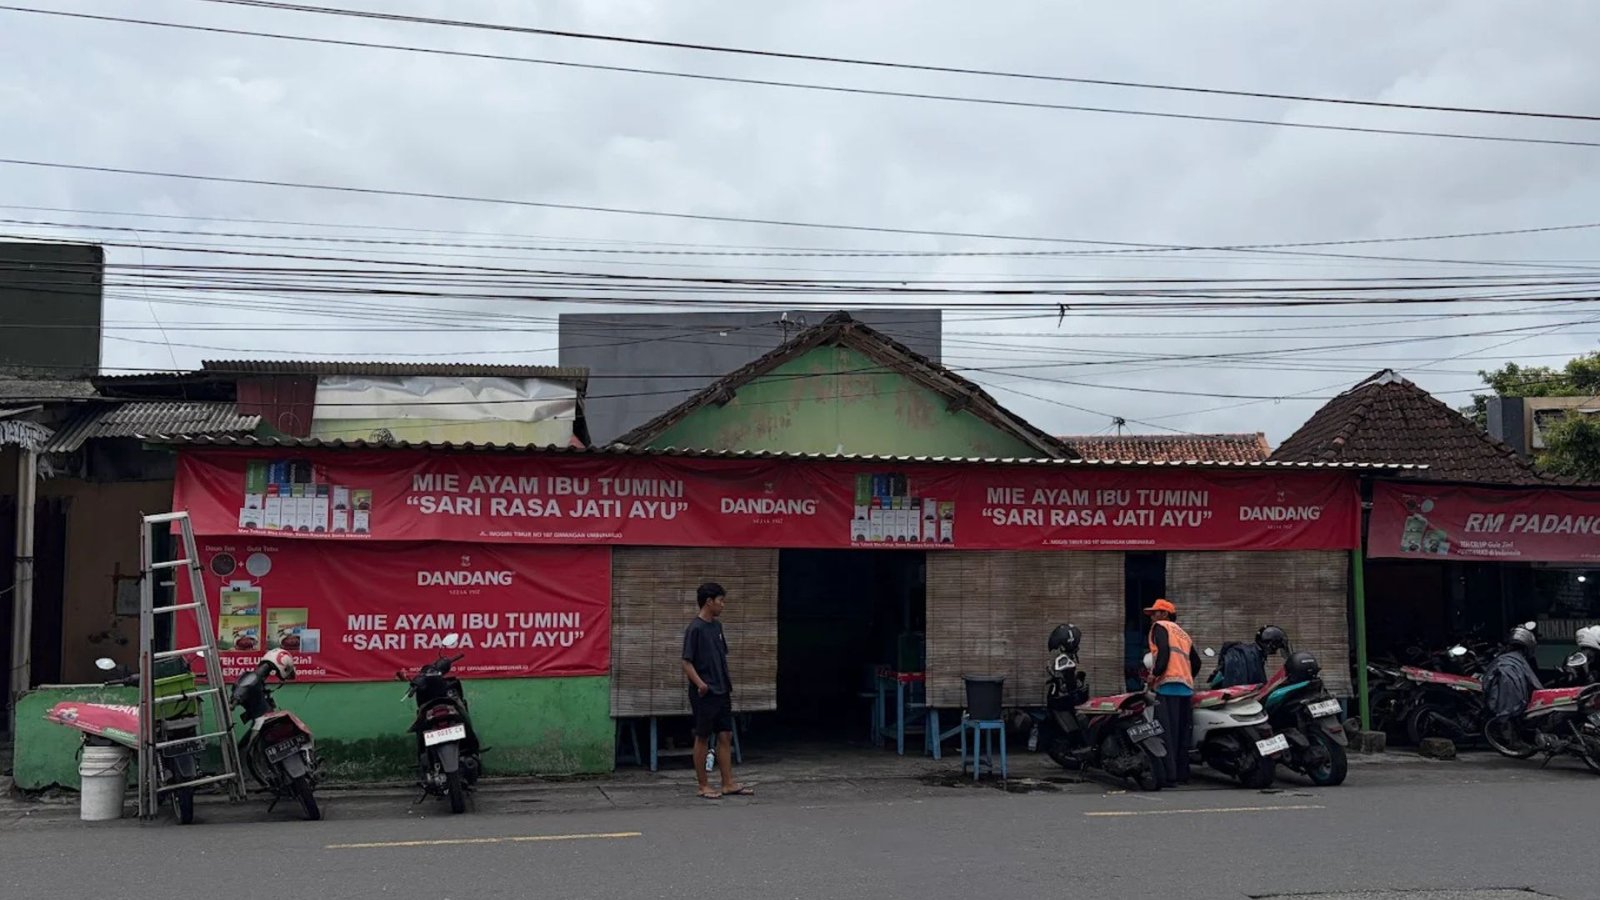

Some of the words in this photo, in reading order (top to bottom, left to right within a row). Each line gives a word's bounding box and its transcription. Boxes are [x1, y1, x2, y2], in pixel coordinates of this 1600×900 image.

[413, 474, 459, 492] MIE
[468, 475, 538, 495] AYAM
[548, 477, 590, 496] IBU
[598, 478, 684, 498] TUMINI
[720, 498, 816, 515] DANDANG
[987, 487, 1024, 505] MIE
[1032, 488, 1089, 506] AYAM
[1096, 489, 1130, 506] IBU
[1136, 490, 1208, 507] TUMINI
[490, 498, 562, 518] RASA
[569, 499, 621, 518] JATI
[1051, 508, 1107, 526] RASA
[1112, 509, 1154, 527] JATI
[1239, 506, 1320, 522] DANDANG
[1464, 513, 1505, 533] RM
[417, 571, 512, 586] DANDANG
[348, 614, 388, 631] MIE
[394, 614, 454, 630] AYAM
[462, 613, 498, 629] IBU
[505, 612, 580, 629] TUMINI
[480, 632, 525, 648] JATI
[236, 657, 261, 665] CELU
